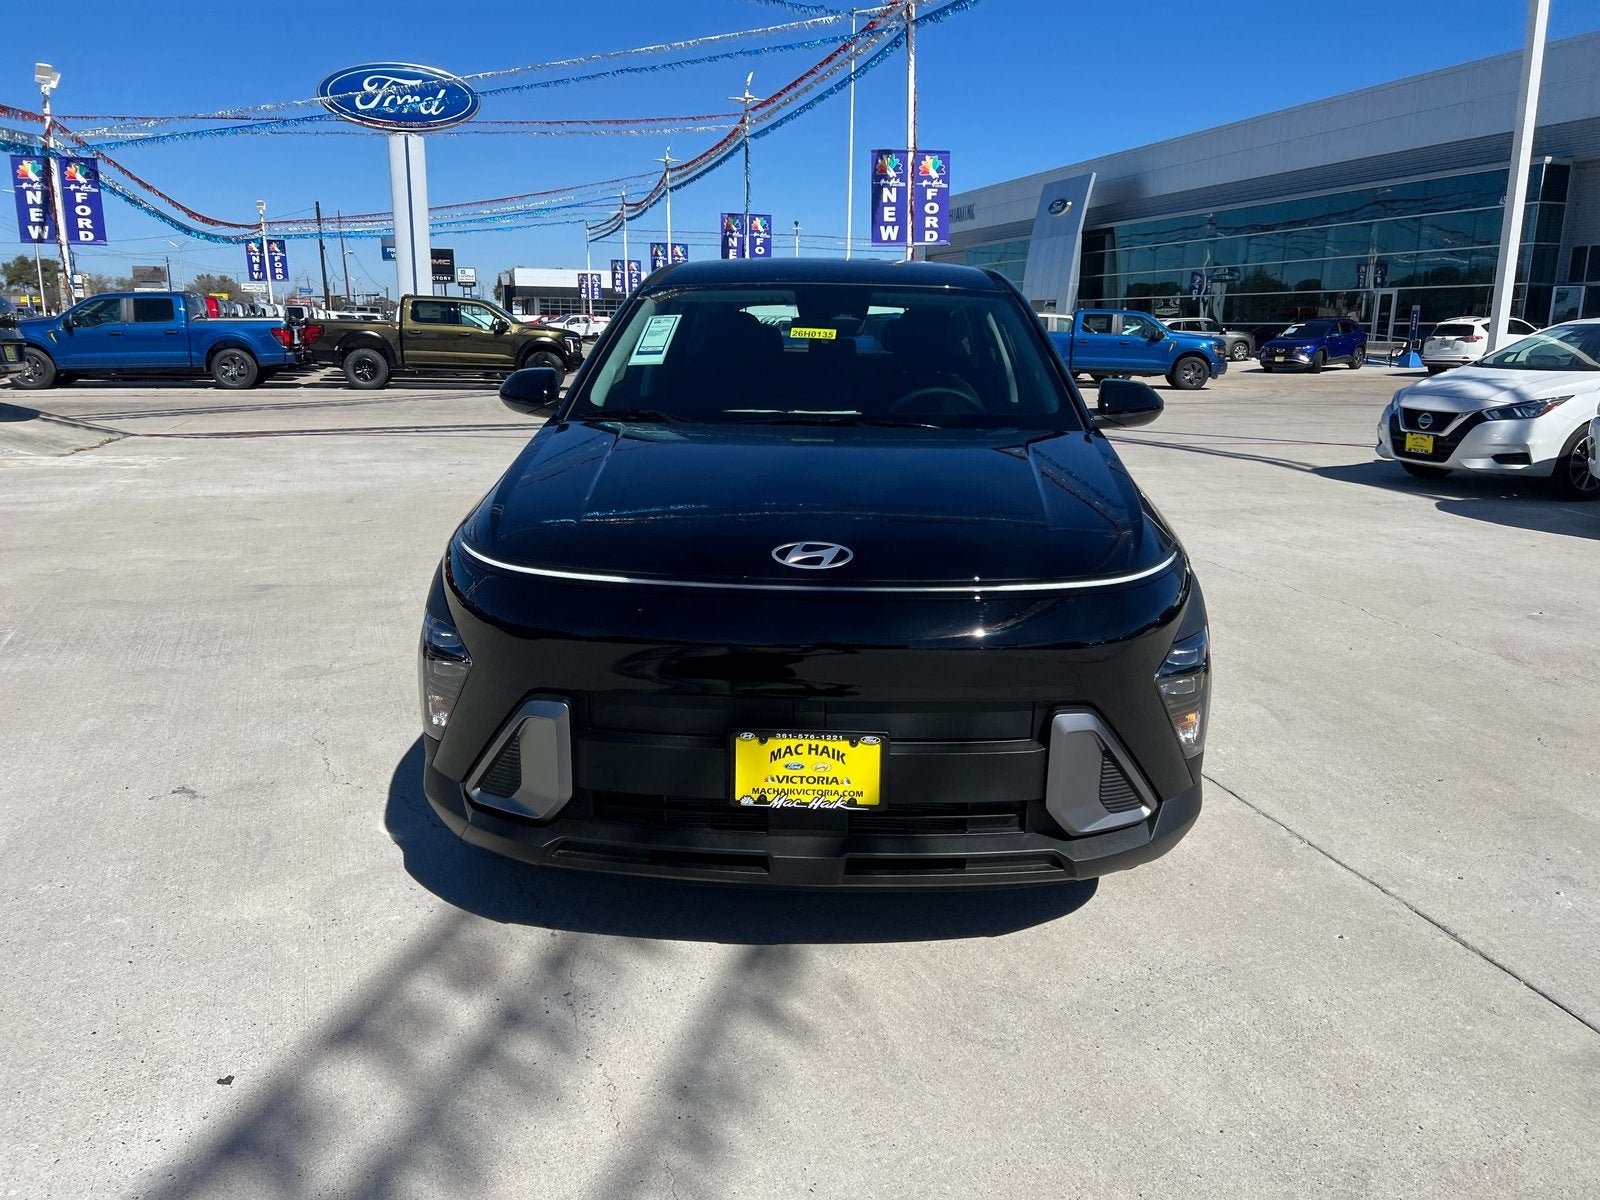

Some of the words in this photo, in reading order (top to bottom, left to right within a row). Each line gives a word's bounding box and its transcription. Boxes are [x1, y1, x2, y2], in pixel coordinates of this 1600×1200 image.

[355, 75, 446, 115] Ford
[26, 190, 49, 239] NEW
[75, 192, 94, 241] FORD
[880, 187, 899, 241] NEW
[925, 188, 940, 242] FORD
[728, 237, 738, 259] NE
[755, 238, 765, 255] FO
[252, 255, 263, 279] NEW
[274, 256, 284, 280] FORD
[615, 272, 623, 293] NEW
[792, 329, 834, 339] 26H0135
[775, 732, 844, 741] 361-576-1221
[770, 744, 804, 763] MAC
[808, 744, 846, 765] HAIK
[776, 775, 840, 786] VICTORIA
[752, 787, 864, 798] MACHAIKVICTORIA.COM
[770, 794, 807, 809] Mac
[808, 795, 850, 810] Haik
